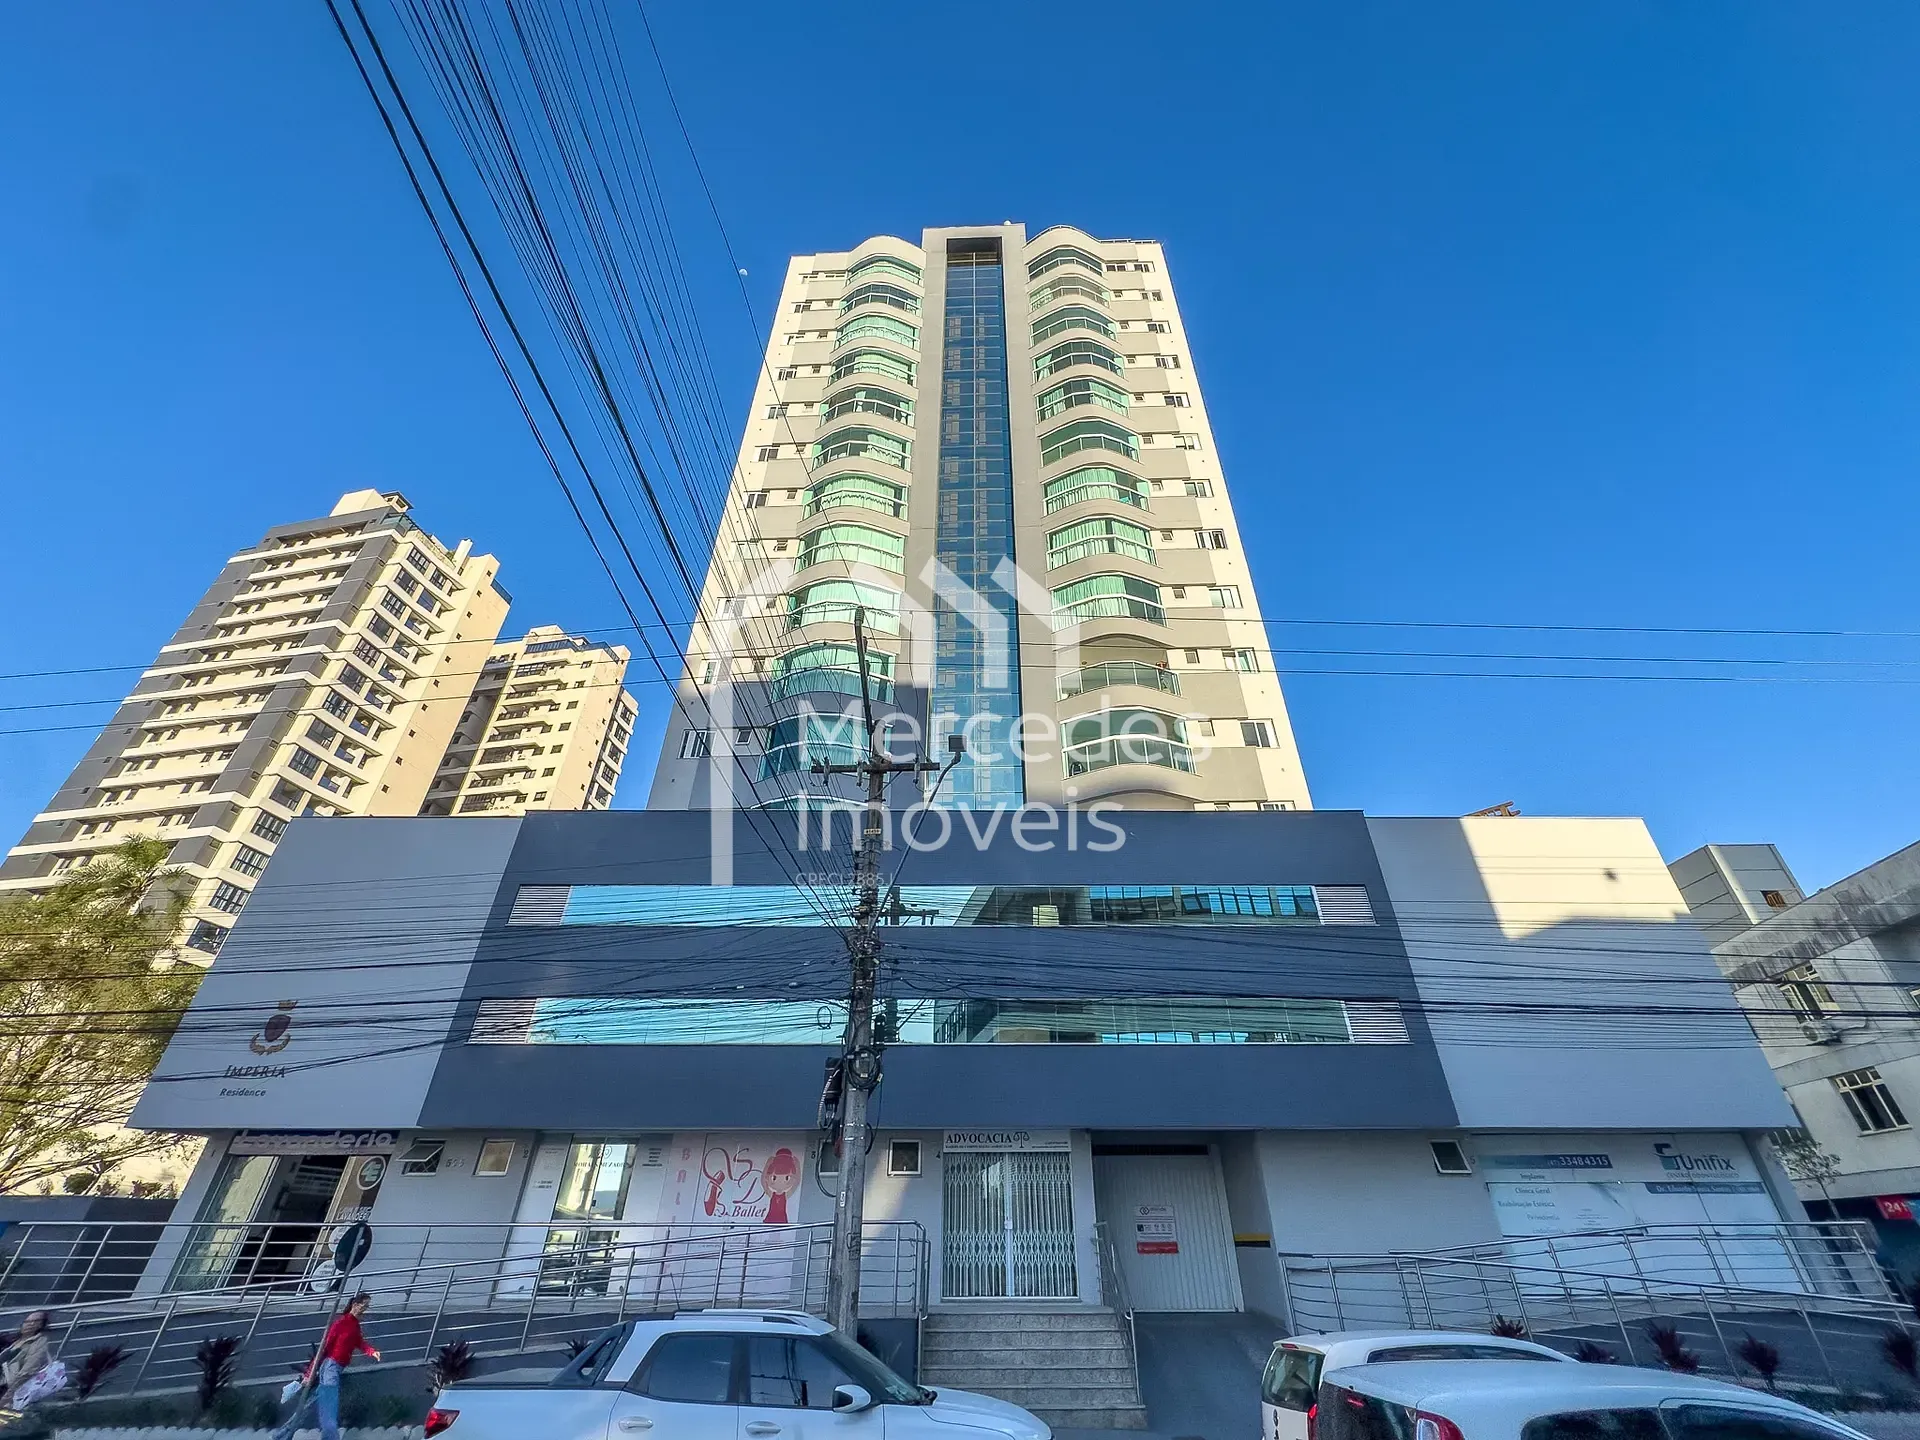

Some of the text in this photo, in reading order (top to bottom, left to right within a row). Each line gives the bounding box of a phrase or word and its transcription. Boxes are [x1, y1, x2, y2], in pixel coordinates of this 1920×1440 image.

[224, 1065, 286, 1079] IMPERIA
[219, 1088, 267, 1097] Residence
[945, 1132, 1012, 1144] ADVOCACIA
[1680, 1154, 1737, 1171] Unifix
[732, 1205, 767, 1218] Ballet
